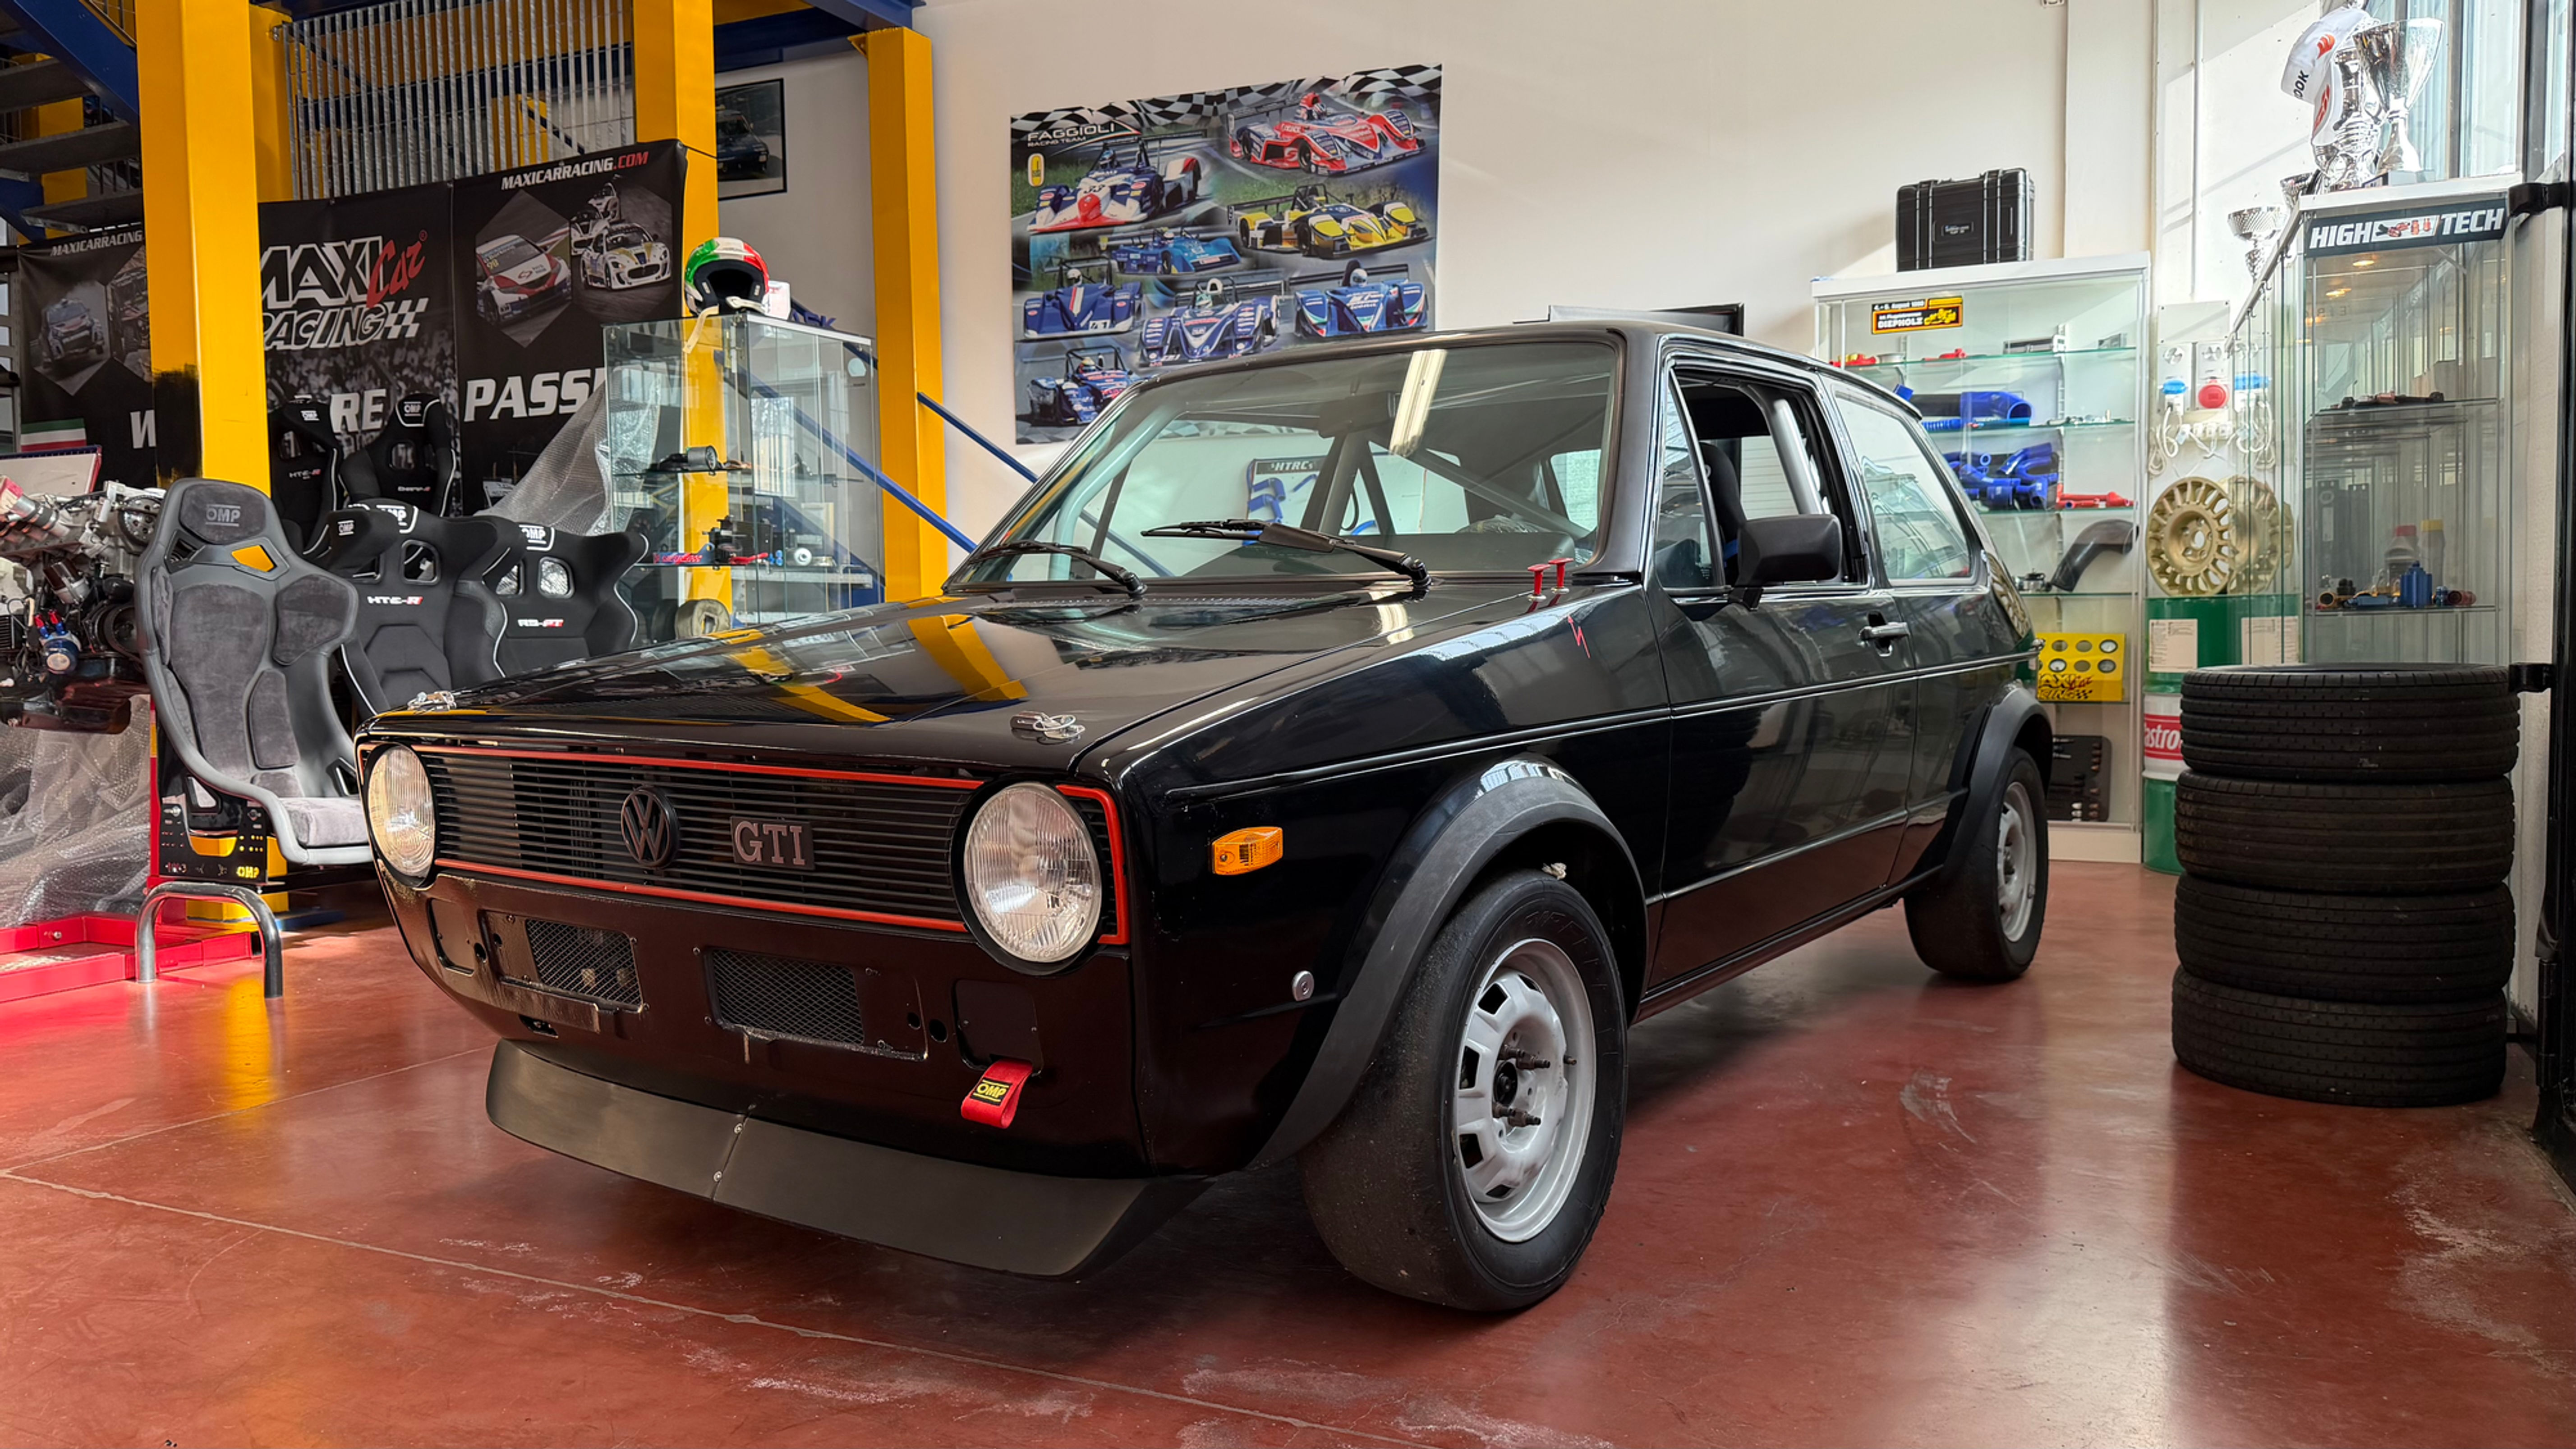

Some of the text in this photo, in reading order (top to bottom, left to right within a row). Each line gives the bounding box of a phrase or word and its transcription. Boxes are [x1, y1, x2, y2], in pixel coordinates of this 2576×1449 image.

[1028, 123, 1114, 141] FAGGIOLI
[501, 152, 649, 190] MAXICARRACING.COM
[2309, 208, 2505, 249] HIGH TECH
[51, 230, 143, 257] MAXICARRACING
[404, 405, 421, 413] OMP
[205, 506, 241, 520] OMP
[2145, 724, 2183, 750] astro
[622, 790, 670, 863] VW
[735, 820, 806, 865] GTI
[977, 1082, 1007, 1098] OMP
